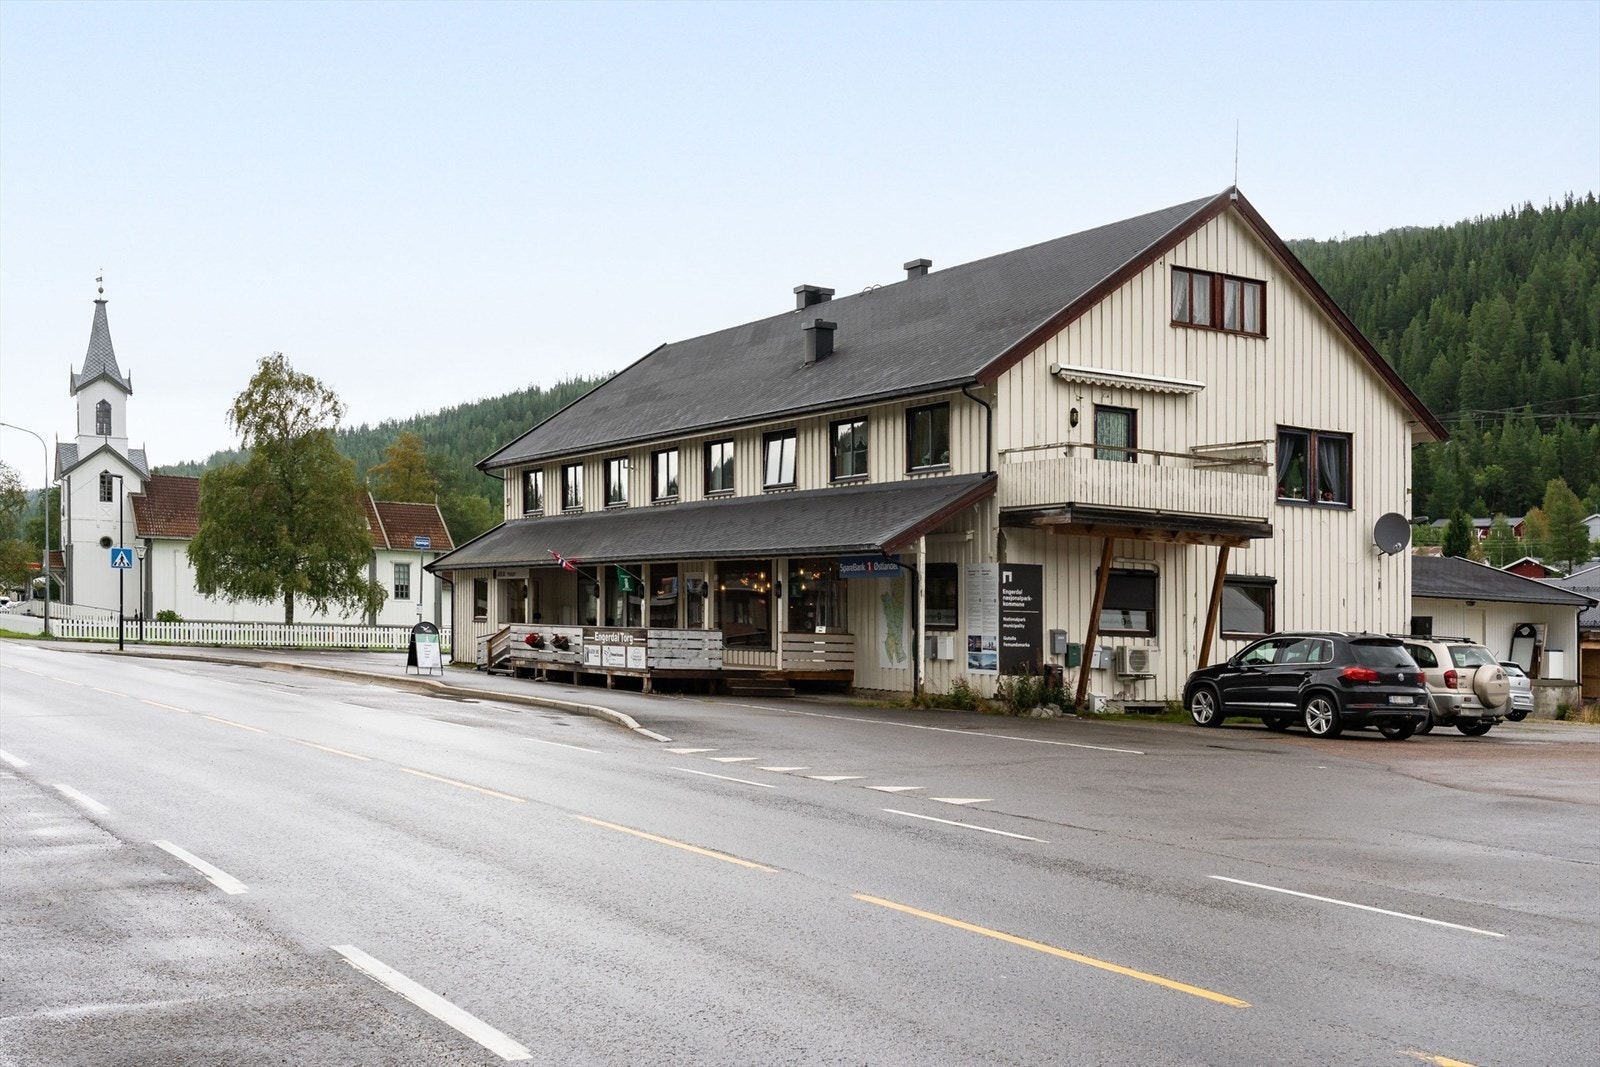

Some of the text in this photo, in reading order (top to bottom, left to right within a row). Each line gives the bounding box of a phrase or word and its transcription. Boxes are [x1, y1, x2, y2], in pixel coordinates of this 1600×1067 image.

[839, 562, 866, 573] SpareBank
[867, 561, 872, 571] 1
[594, 631, 634, 645] Engerdal Torg
